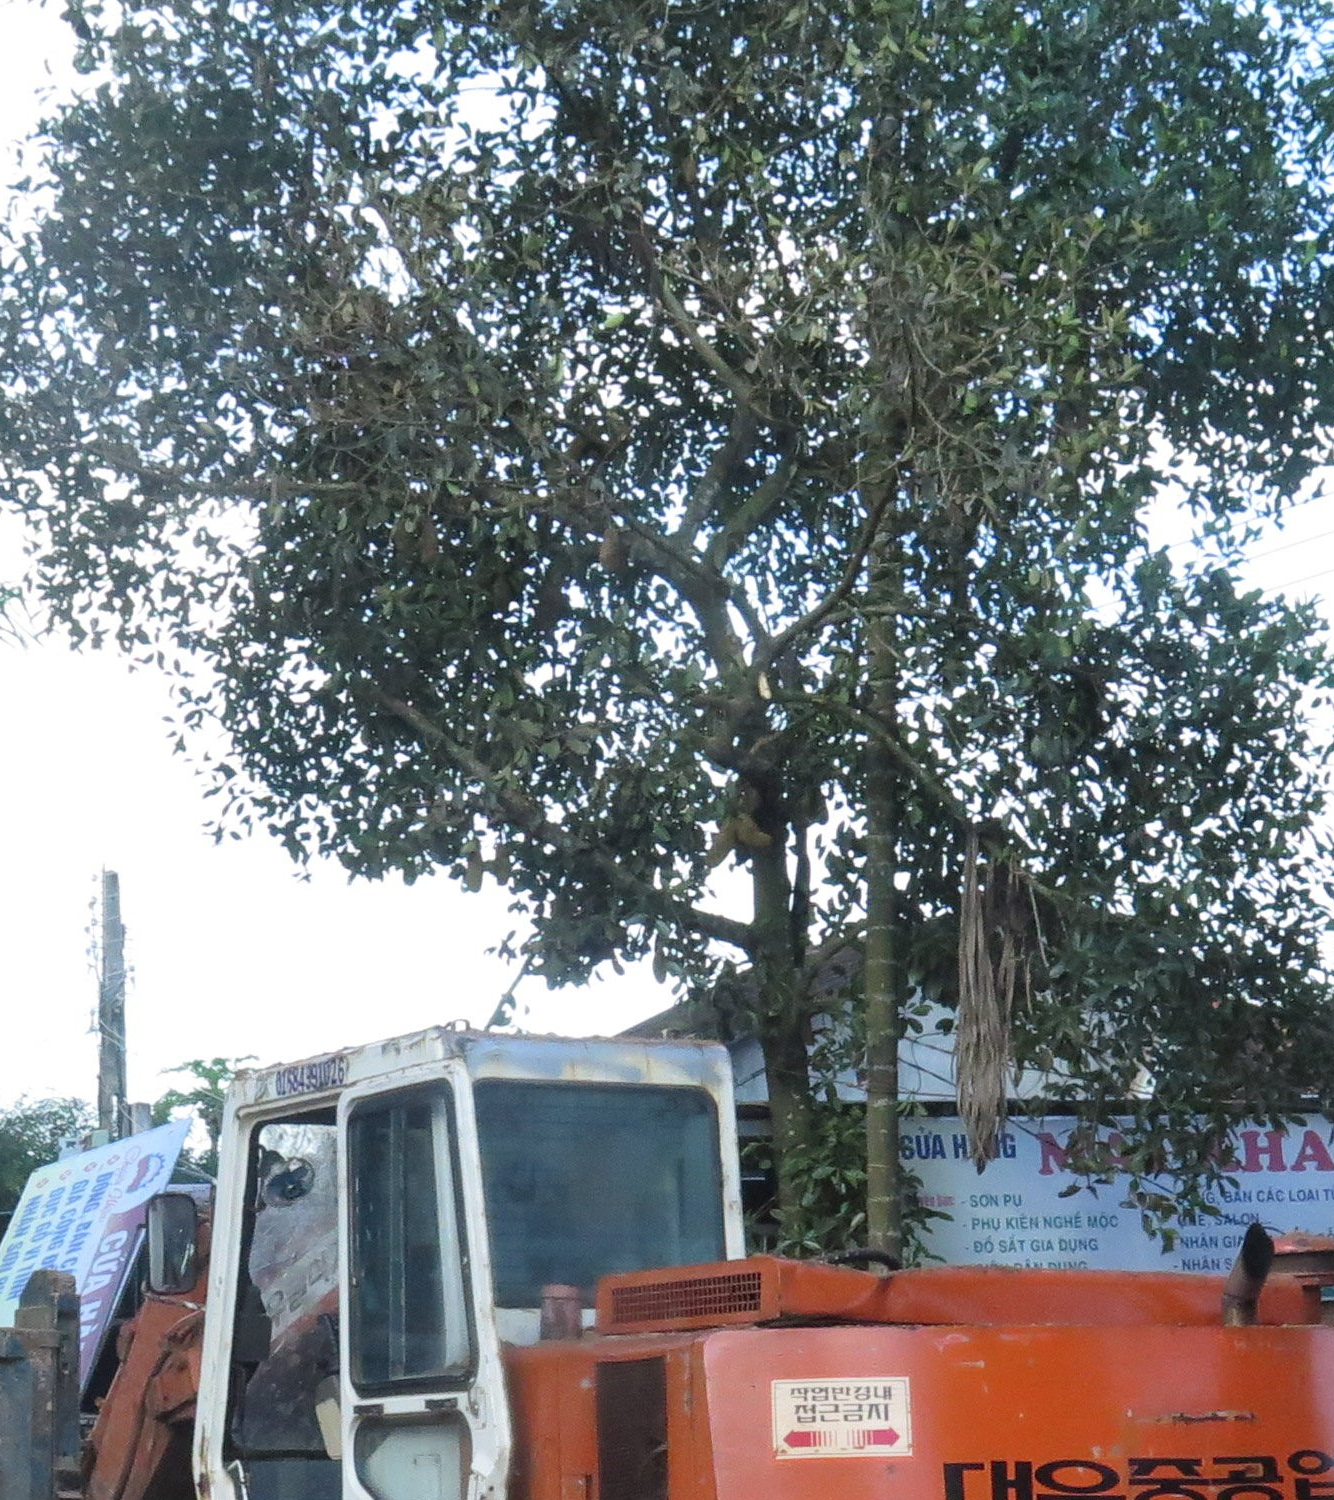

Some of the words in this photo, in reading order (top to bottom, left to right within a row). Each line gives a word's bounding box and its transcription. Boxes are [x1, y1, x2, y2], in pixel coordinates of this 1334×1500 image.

[952, 1132, 1018, 1160] HG
[1003, 1194, 1022, 1207] PU
[1030, 1238, 1054, 1252] GIA
